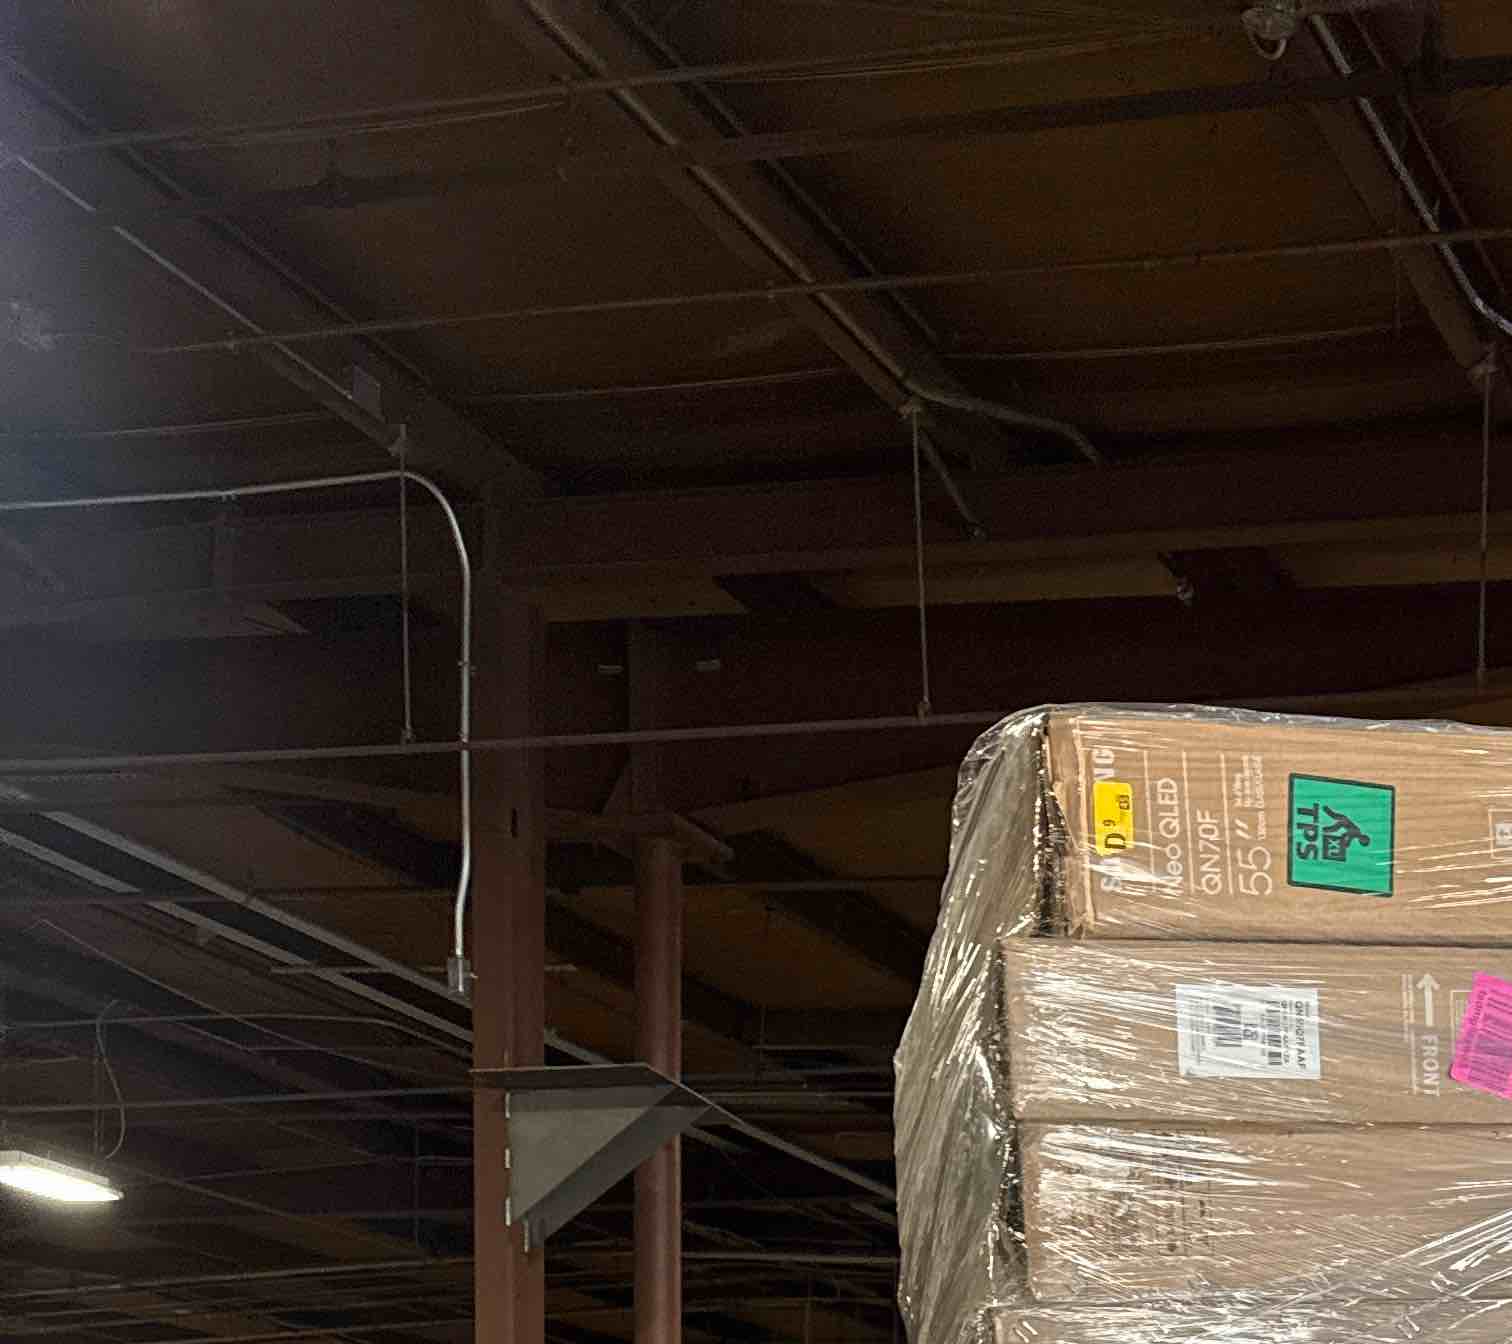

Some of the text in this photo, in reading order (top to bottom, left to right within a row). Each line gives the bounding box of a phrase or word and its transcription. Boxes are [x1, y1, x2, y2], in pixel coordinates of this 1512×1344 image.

[1158, 777, 1180, 838] QLED
[1296, 803, 1319, 860] TPS
[1105, 833, 1126, 850] D
[1197, 808, 1222, 895] QN70F
[1421, 1034, 1440, 1097] FRONT
